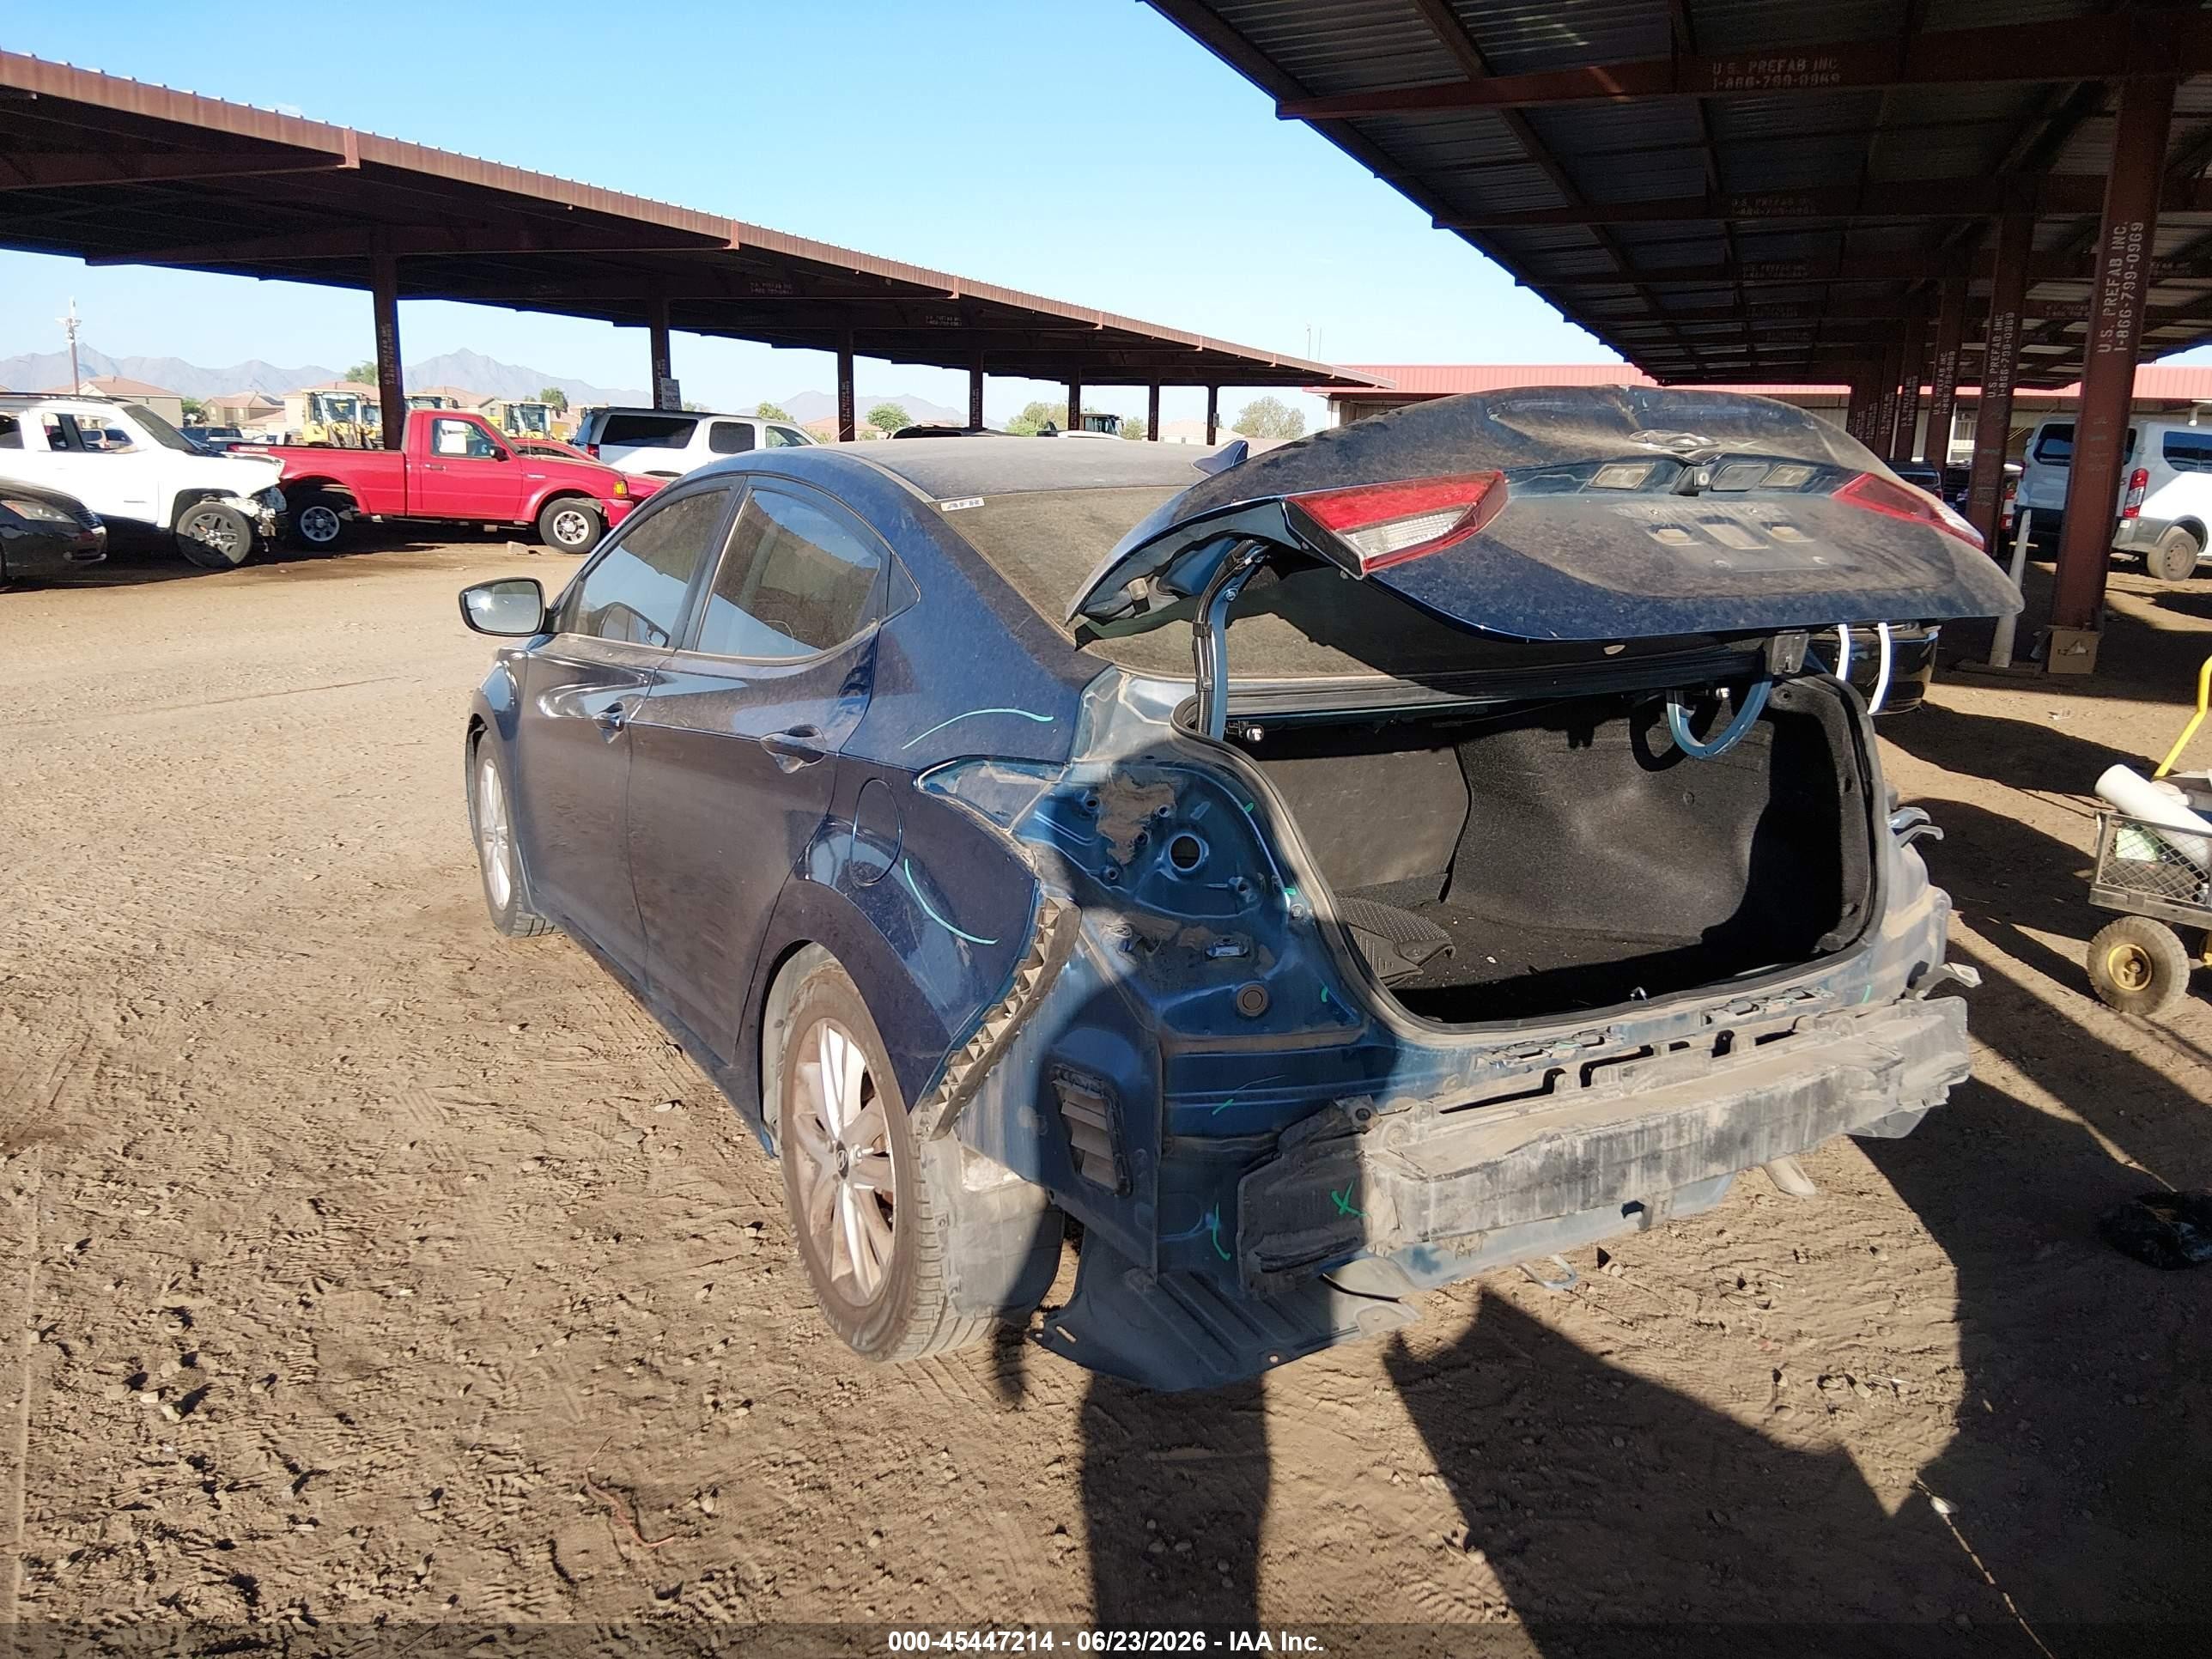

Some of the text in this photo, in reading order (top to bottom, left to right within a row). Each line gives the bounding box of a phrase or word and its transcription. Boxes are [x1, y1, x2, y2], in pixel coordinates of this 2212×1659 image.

[1748, 58, 1807, 73] PREFAB
[2096, 222, 2129, 354] U.S. PREFAB INC.
[2113, 222, 2144, 352] 1-866-799-0969
